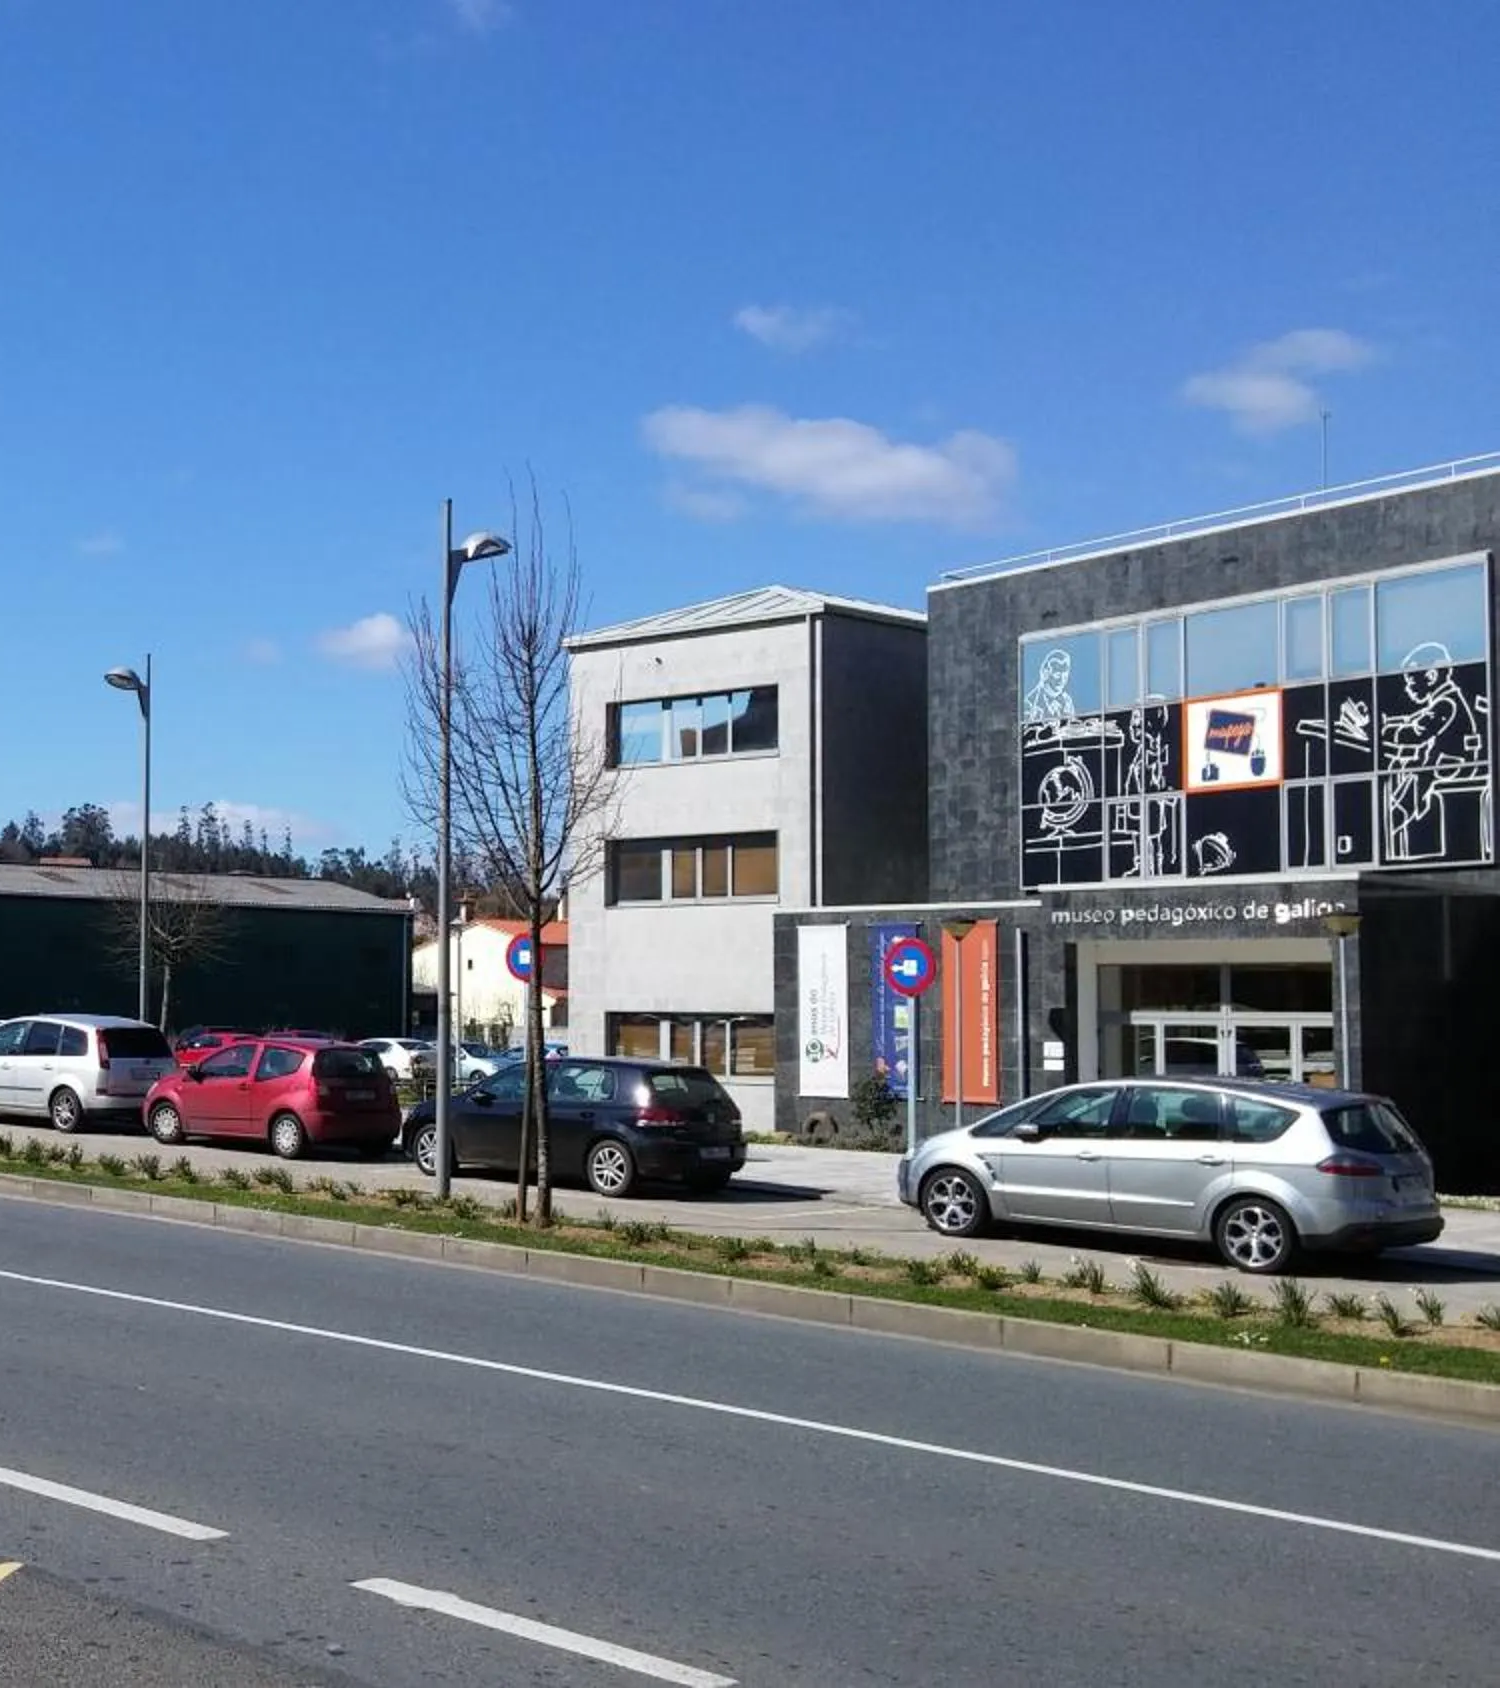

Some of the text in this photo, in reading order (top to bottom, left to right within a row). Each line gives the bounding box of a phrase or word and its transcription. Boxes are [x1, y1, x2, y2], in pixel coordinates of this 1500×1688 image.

[1051, 908, 1115, 924] museo
[1120, 903, 1237, 927] pedagóxico
[1243, 900, 1269, 920] de
